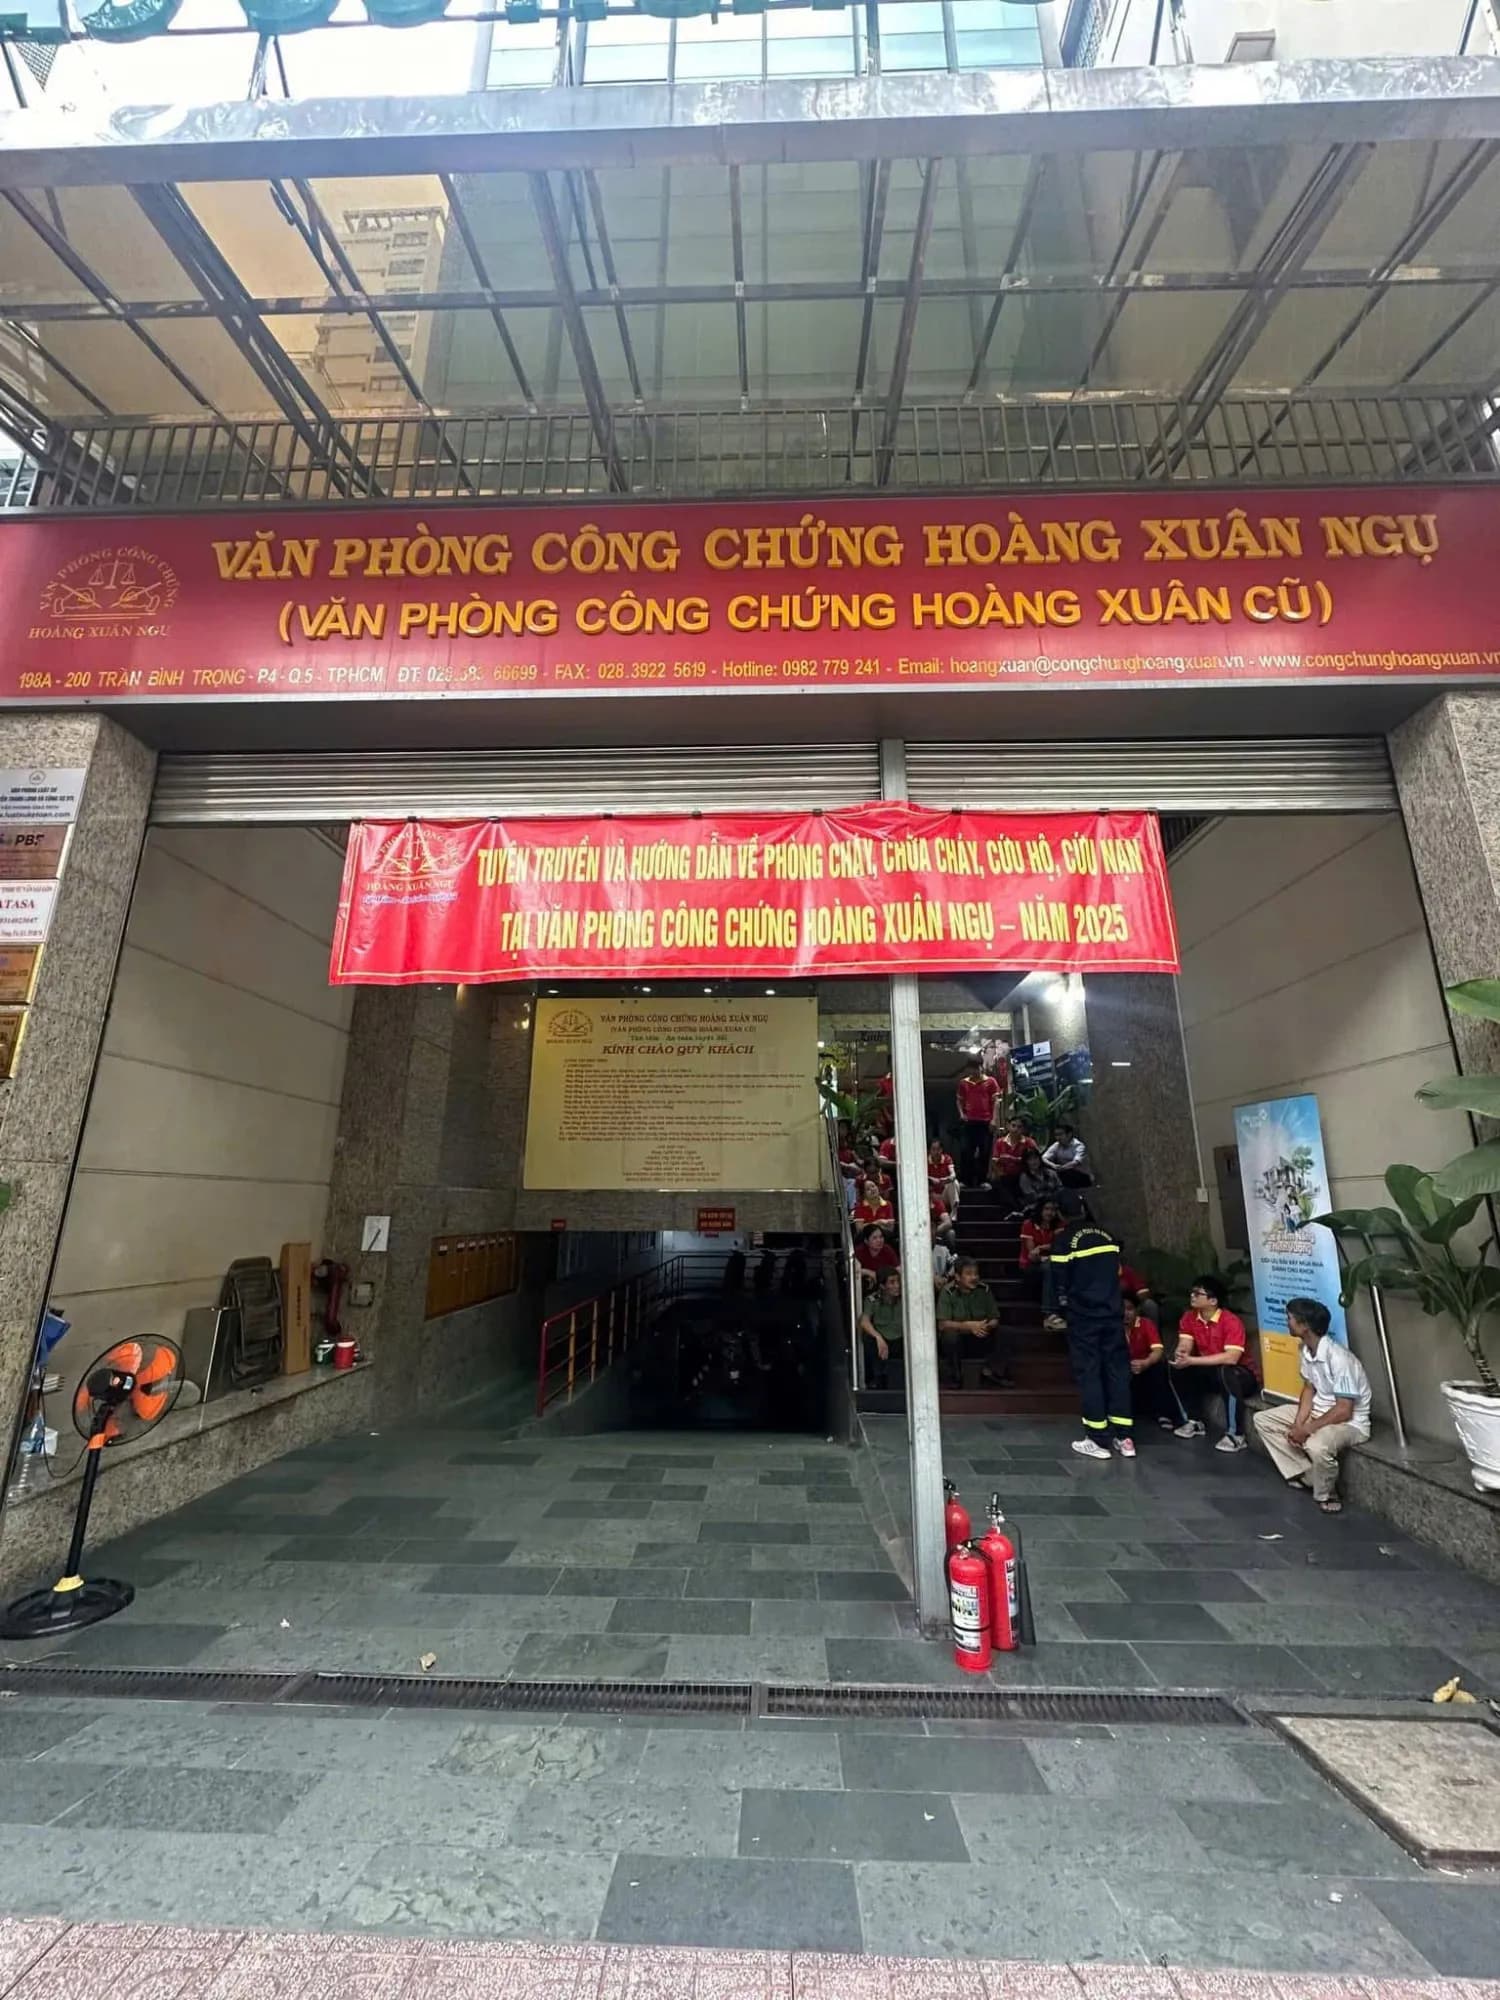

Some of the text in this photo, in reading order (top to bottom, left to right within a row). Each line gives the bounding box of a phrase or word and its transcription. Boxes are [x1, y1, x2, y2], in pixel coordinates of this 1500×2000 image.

[211, 507, 1440, 580] VĂN PHÒNG CÔNG CHỨNG HOÀNG XUÂN NGỤ
[278, 576, 1333, 646] (VĂN PHÒNG CÔNG CHỨNG HOÀNG XUÂN CŨ)
[18, 671, 51, 688] 198A
[64, 671, 91, 688] 200
[148, 666, 184, 686] BÌNH
[192, 668, 246, 688] TRỌNG
[493, 664, 538, 681] 66699
[555, 663, 591, 681] FAX:
[598, 662, 666, 680] 028.3922
[673, 661, 706, 679] 5619
[722, 659, 777, 678] Hotline:
[782, 659, 818, 677] 0982
[822, 658, 849, 676] 779
[854, 658, 880, 675] 241
[898, 657, 945, 675] Email:
[950, 654, 1244, 677] hoangxuan@congchunghoangxuan.vn
[477, 840, 529, 886] TUYÊN
[533, 835, 600, 882] TRUYỀN
[604, 838, 625, 882] VÀ
[630, 838, 690, 880] HƯỚNG
[695, 831, 732, 880] DẪN
[763, 834, 823, 880] PHÒNG
[934, 833, 984, 879] CHÁY,
[986, 833, 1025, 875] CỨU
[1026, 832, 1062, 882] HỘ,
[1061, 831, 1098, 876] CỨU
[1100, 838, 1144, 882] NẠN
[502, 911, 530, 960] TẠI
[537, 903, 579, 949] VĂN
[582, 901, 655, 949] PHÒNG
[660, 900, 718, 948] CÔNG
[724, 899, 797, 948] CHỨNG
[803, 898, 877, 946] HOÀNG
[882, 892, 943, 943] XUÂN
[948, 902, 994, 949] NGỤ
[1019, 893, 1070, 942] NĂM
[1073, 903, 1129, 944] 2025
[602, 1044, 635, 1055] KÍNH
[637, 1043, 675, 1055] CHÀO
[707, 1043, 756, 1055] KHÁCH
